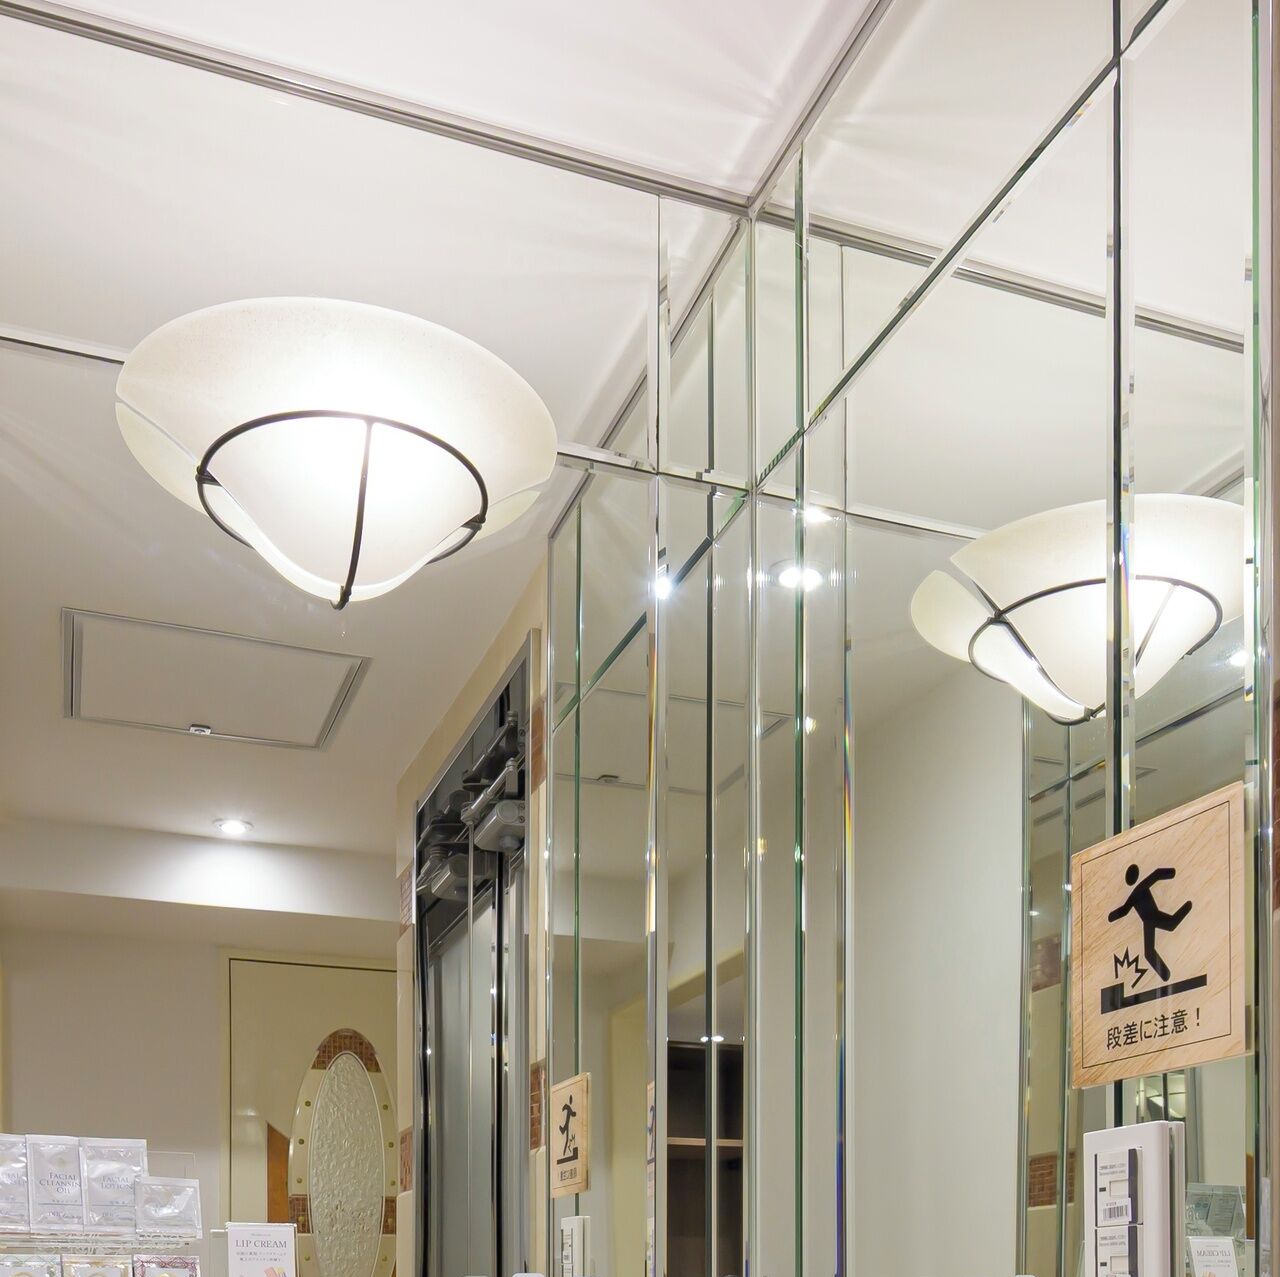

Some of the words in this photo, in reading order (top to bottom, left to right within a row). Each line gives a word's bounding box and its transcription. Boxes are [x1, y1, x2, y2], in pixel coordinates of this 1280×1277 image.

[49, 1172, 77, 1181] FACIAL
[39, 1179, 81, 1188] CLEANSIN
[235, 1239, 252, 1248] LIP
[253, 1239, 287, 1249] CREAM
